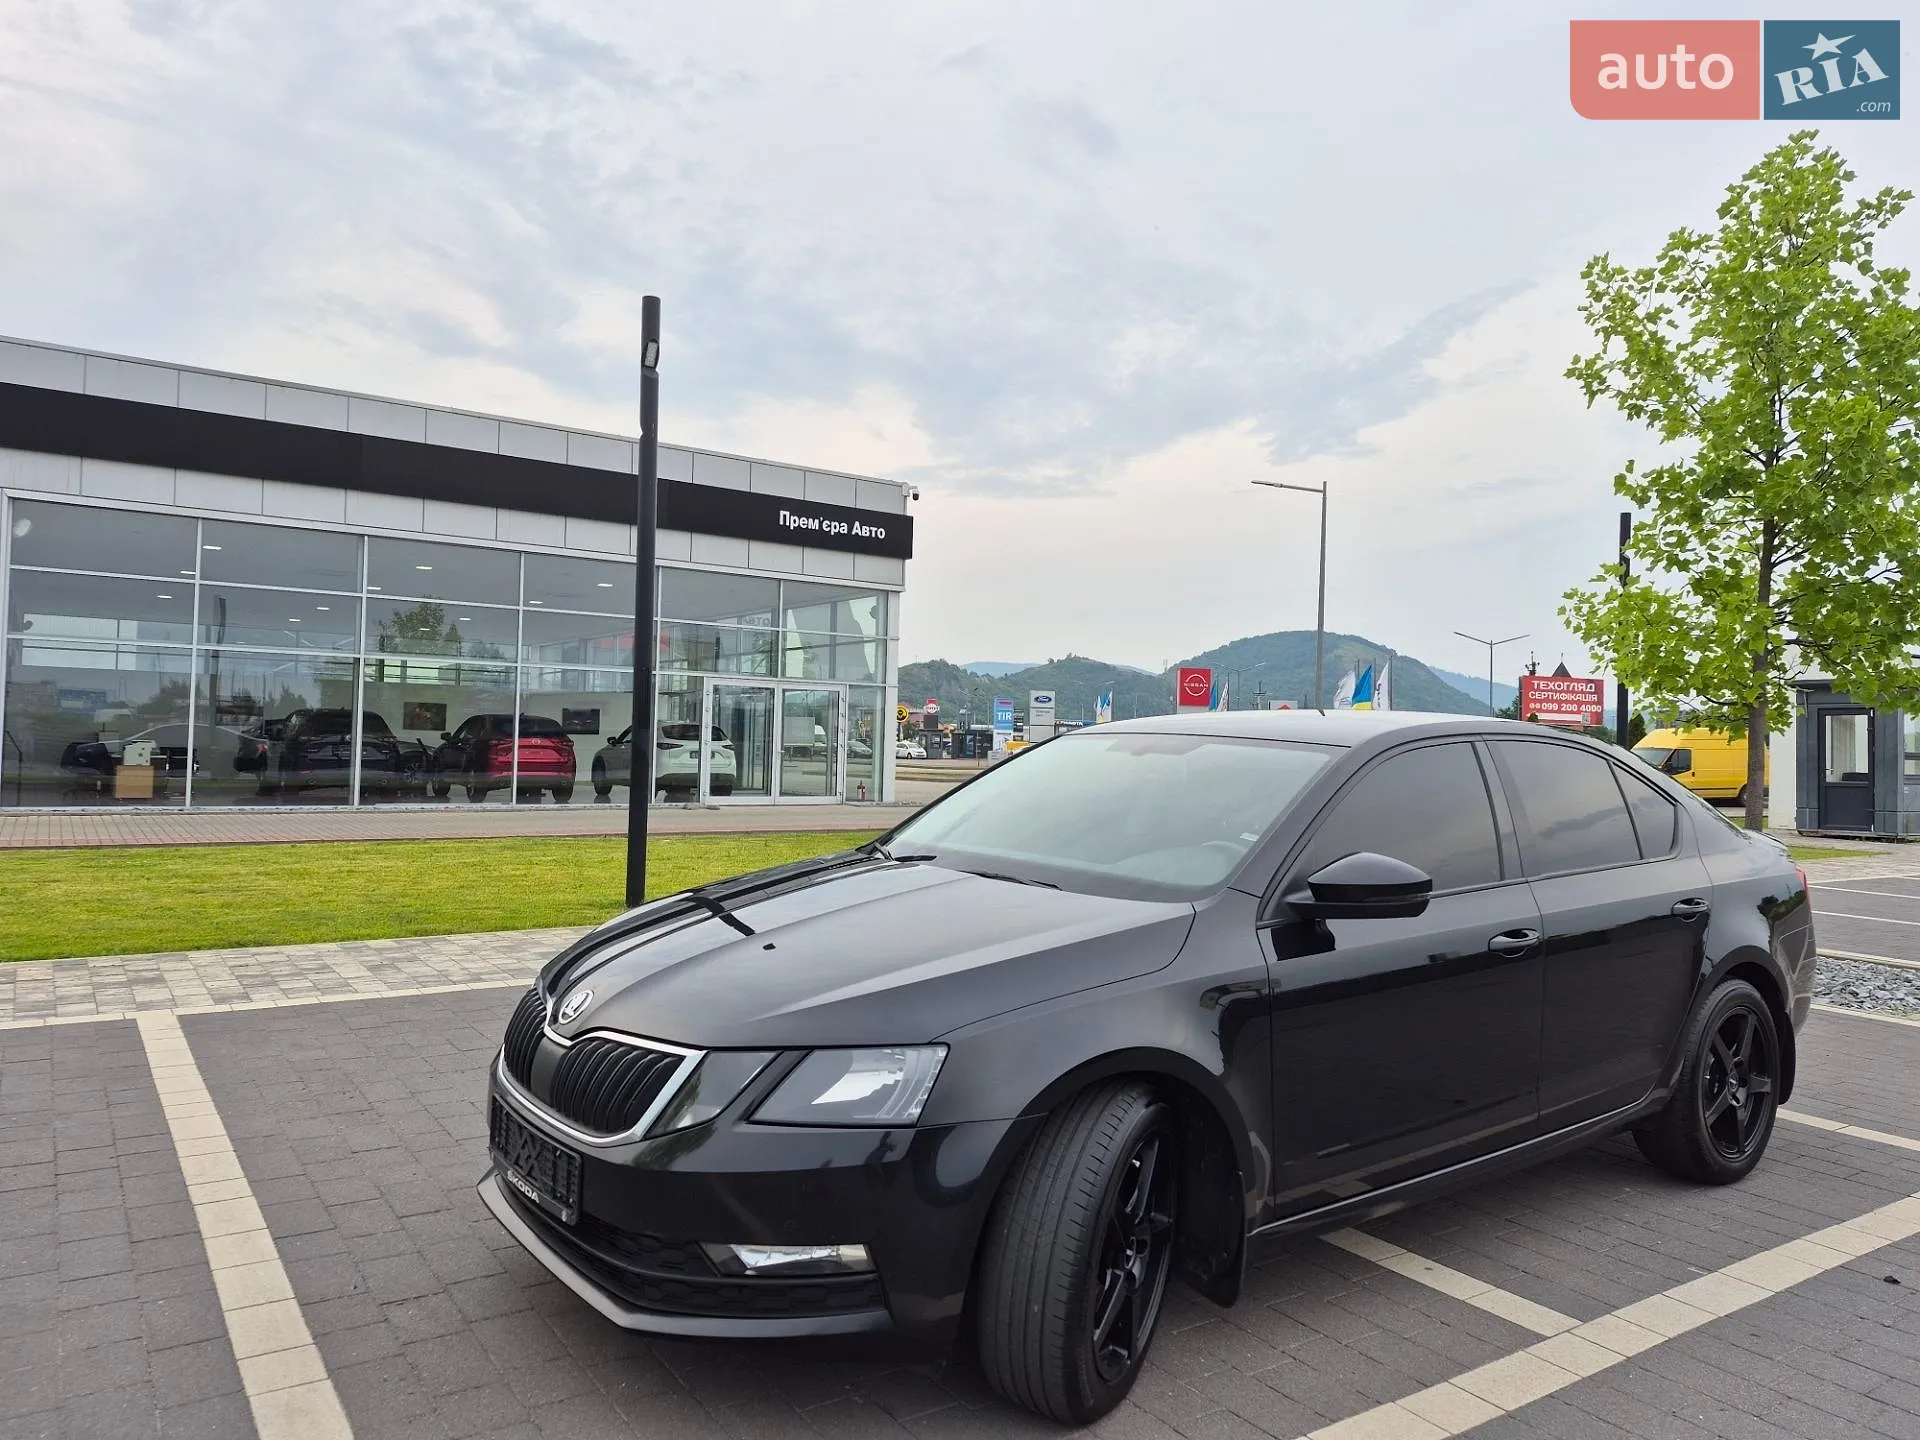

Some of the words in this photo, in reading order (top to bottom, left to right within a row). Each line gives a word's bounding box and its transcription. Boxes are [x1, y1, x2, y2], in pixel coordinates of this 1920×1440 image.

[851, 521, 886, 539] Авто
[1531, 680, 1595, 692] ТЕХОГЛЯД
[1528, 691, 1598, 702] СЕРТИФІКАЦІЯ
[1541, 702, 1559, 711] 099
[1560, 703, 1578, 712] 200
[1580, 704, 1602, 713] 4000
[997, 711, 1012, 721] TIR
